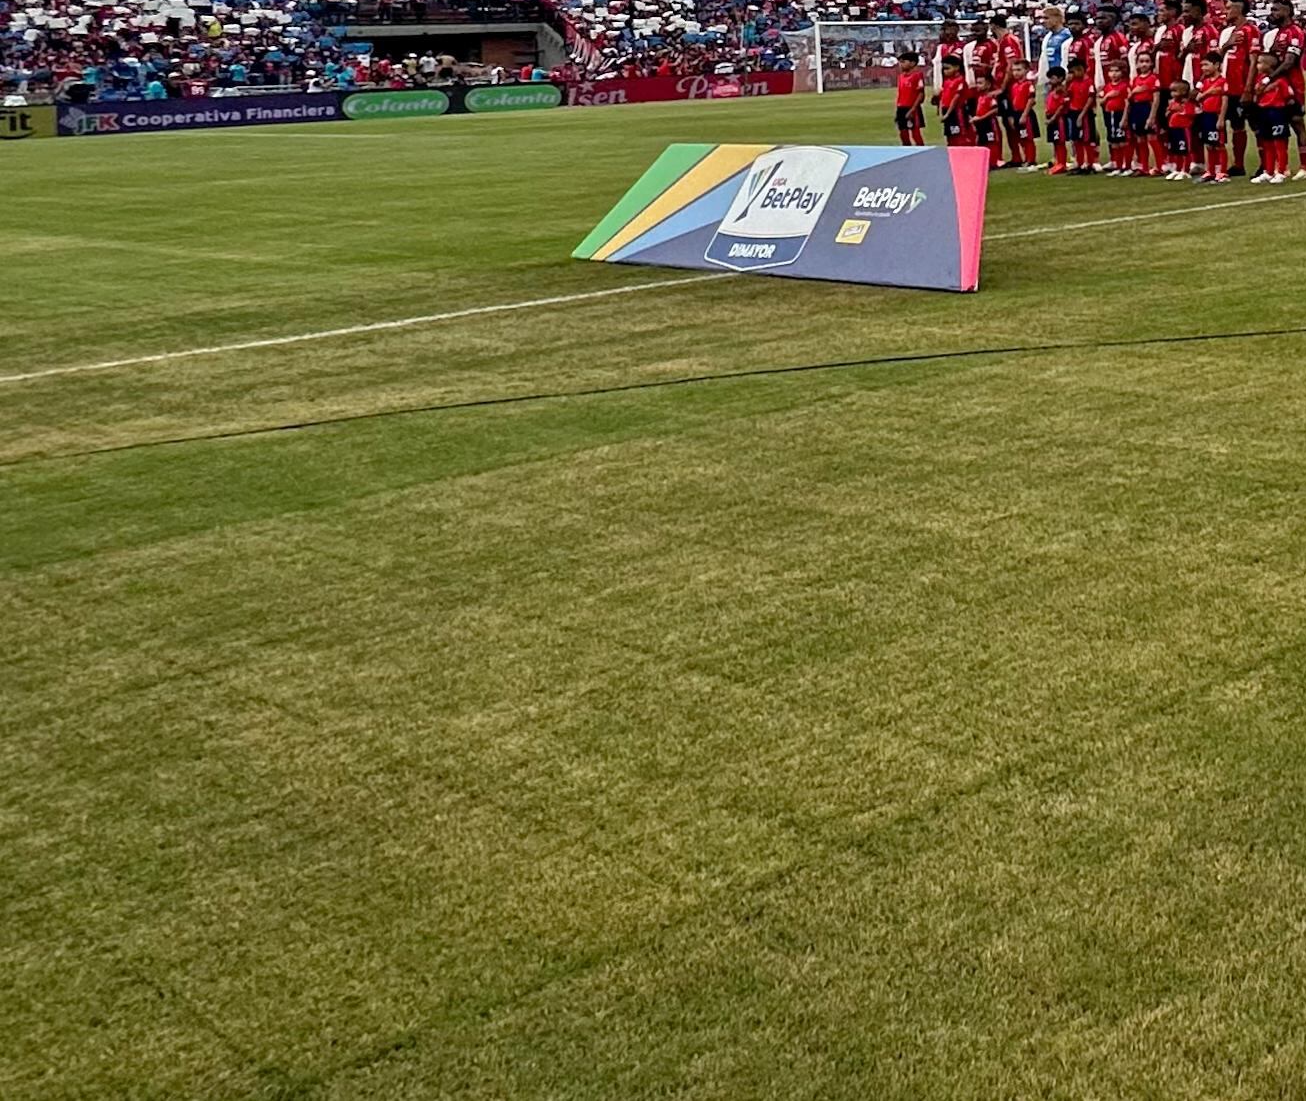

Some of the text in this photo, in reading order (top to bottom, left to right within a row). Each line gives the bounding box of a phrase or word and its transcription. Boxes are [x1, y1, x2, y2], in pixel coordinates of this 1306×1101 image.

[347, 98, 444, 115] Colanta
[470, 92, 556, 107] Colanta
[568, 86, 628, 107] lsen
[122, 109, 241, 127] Cooperativa
[246, 104, 335, 120] Financiera
[760, 185, 825, 214] BetPlay
[853, 186, 911, 214] BetPlay
[728, 243, 776, 259] DIMAYOR
